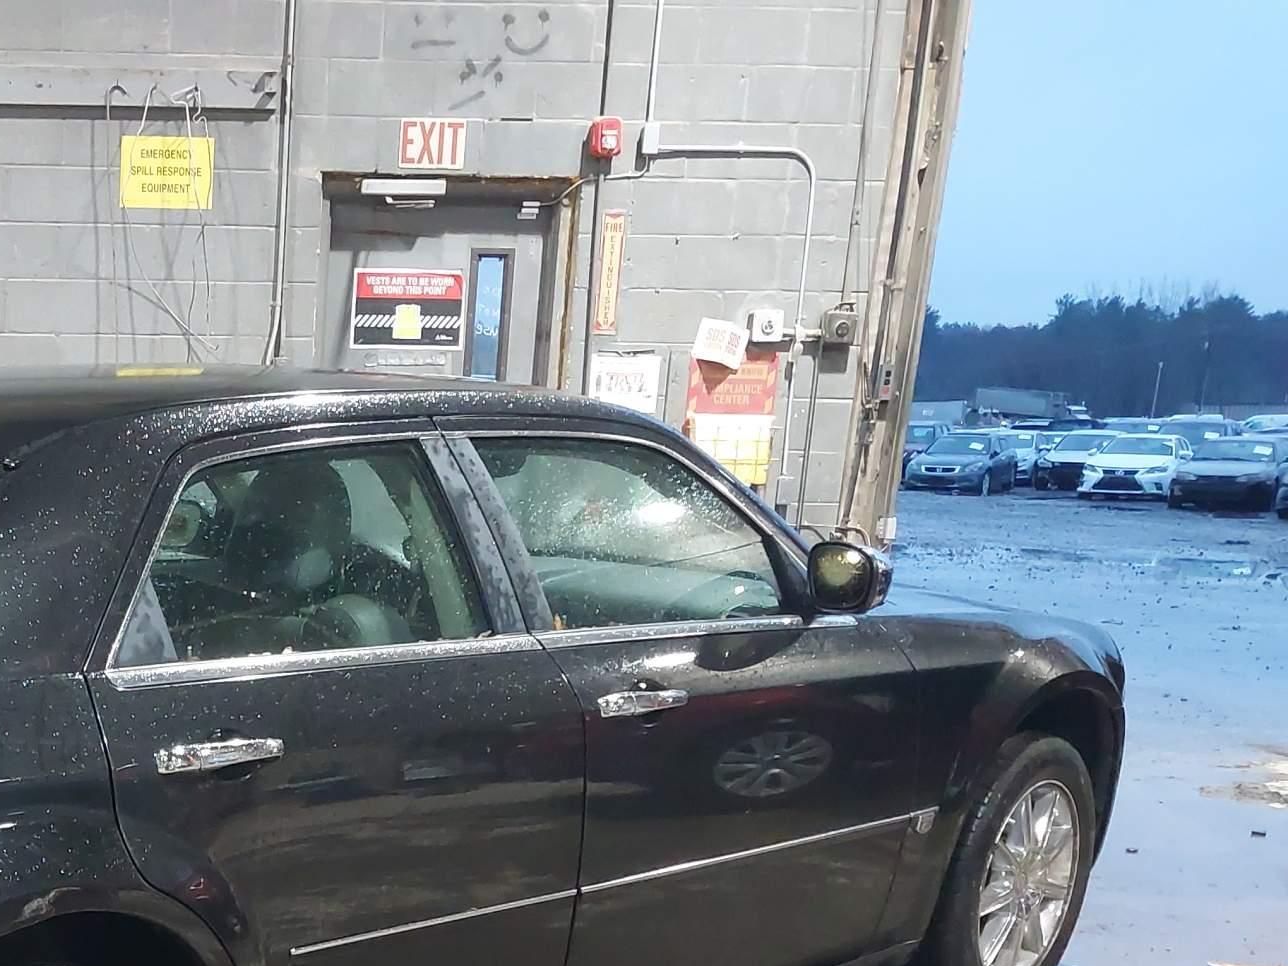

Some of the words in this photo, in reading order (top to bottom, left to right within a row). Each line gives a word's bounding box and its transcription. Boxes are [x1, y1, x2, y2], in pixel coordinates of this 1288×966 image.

[401, 121, 464, 165] EXIT
[140, 149, 192, 160] EMERGENCY
[131, 166, 154, 176] SPILL
[156, 167, 202, 177] RESPONSE
[141, 183, 190, 193] EQUIPMENT
[605, 222, 623, 233] FIRE
[366, 275, 390, 286] VESTS
[392, 276, 407, 285] ARE
[408, 276, 418, 286] TO
[419, 277, 430, 286] BE
[430, 277, 455, 287] WORN
[373, 285, 404, 295] BEYOND
[405, 286, 423, 295] THIS
[424, 286, 447, 296] POINT
[713, 394, 750, 406] CENTER
